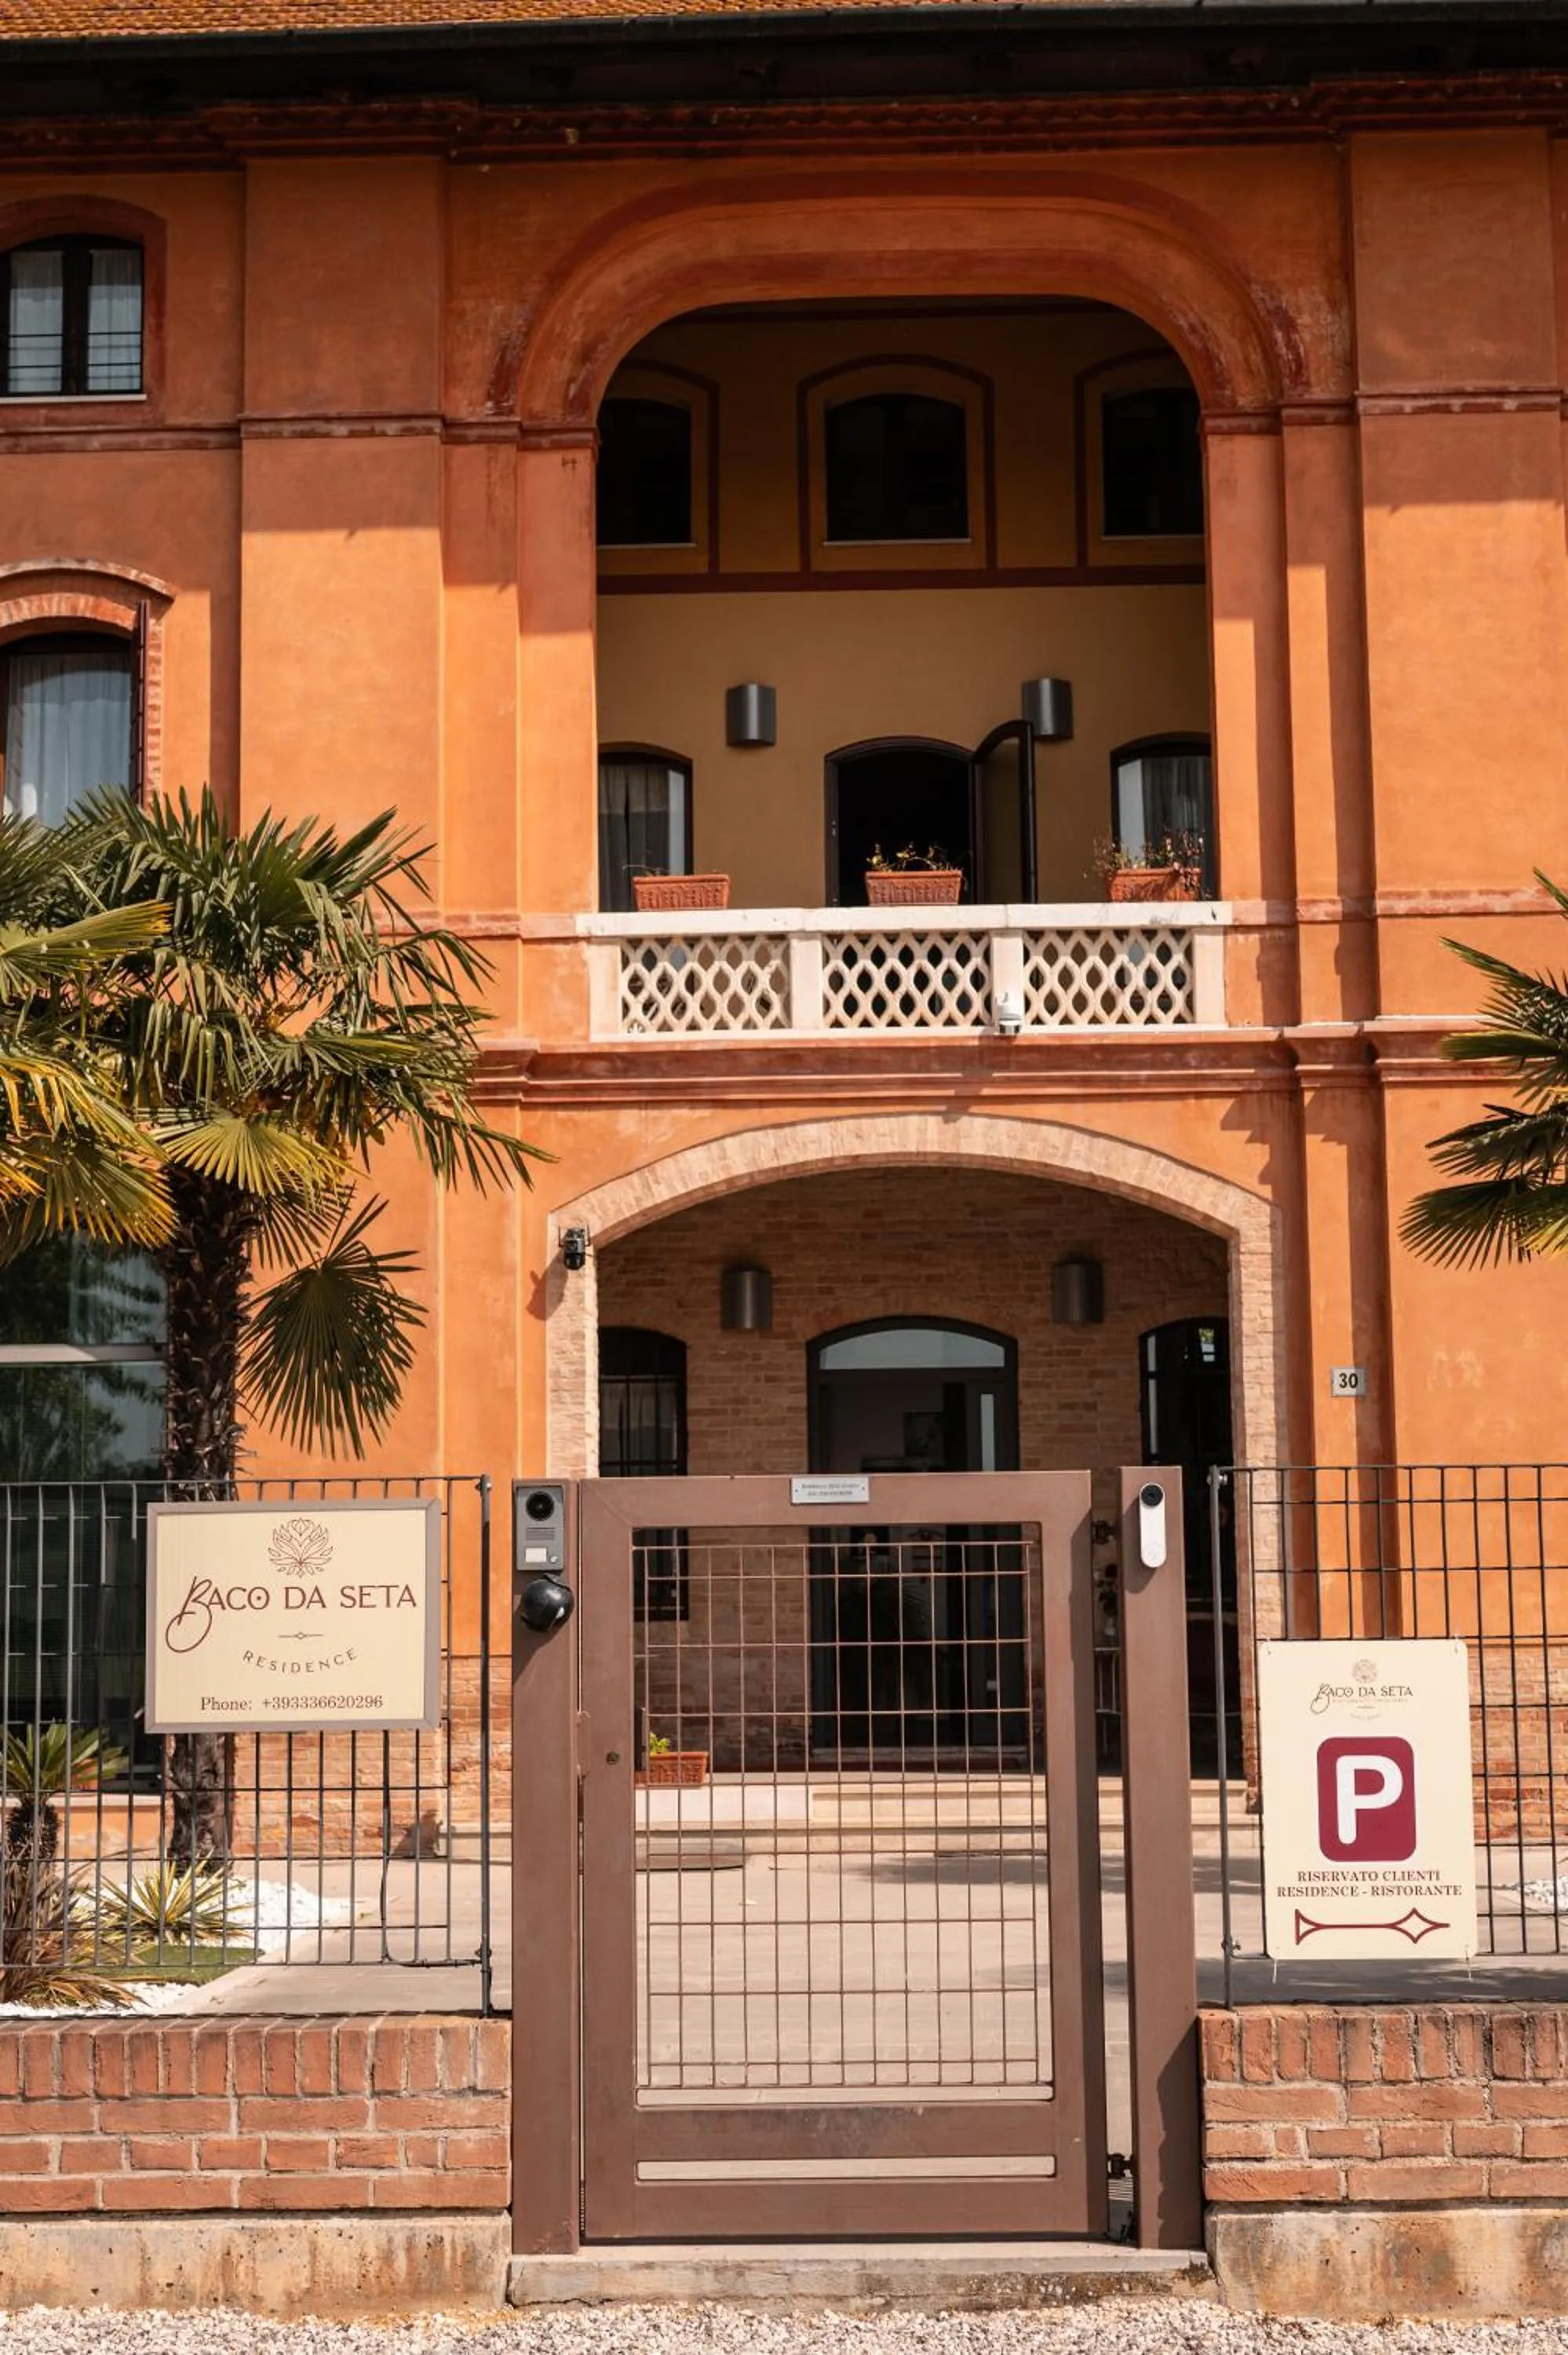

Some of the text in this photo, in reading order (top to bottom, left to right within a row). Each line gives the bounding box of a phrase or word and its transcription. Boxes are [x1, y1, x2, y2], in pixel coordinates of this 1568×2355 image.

[1339, 1372, 1358, 1389] 30
[165, 1575, 418, 1653] BACO DA SETA
[242, 1648, 358, 1674] RESIDENCE
[1358, 1686, 1376, 1696] DA
[1380, 1685, 1413, 1696] SETA
[200, 1695, 384, 1711] Phone: +393336620296
[1335, 1754, 1403, 1846] P
[1296, 1870, 1441, 1882] RISERVATO CLIENTI
[1277, 1886, 1359, 1897] RESIDENCE
[1370, 1885, 1463, 1897] RISTORANTE
